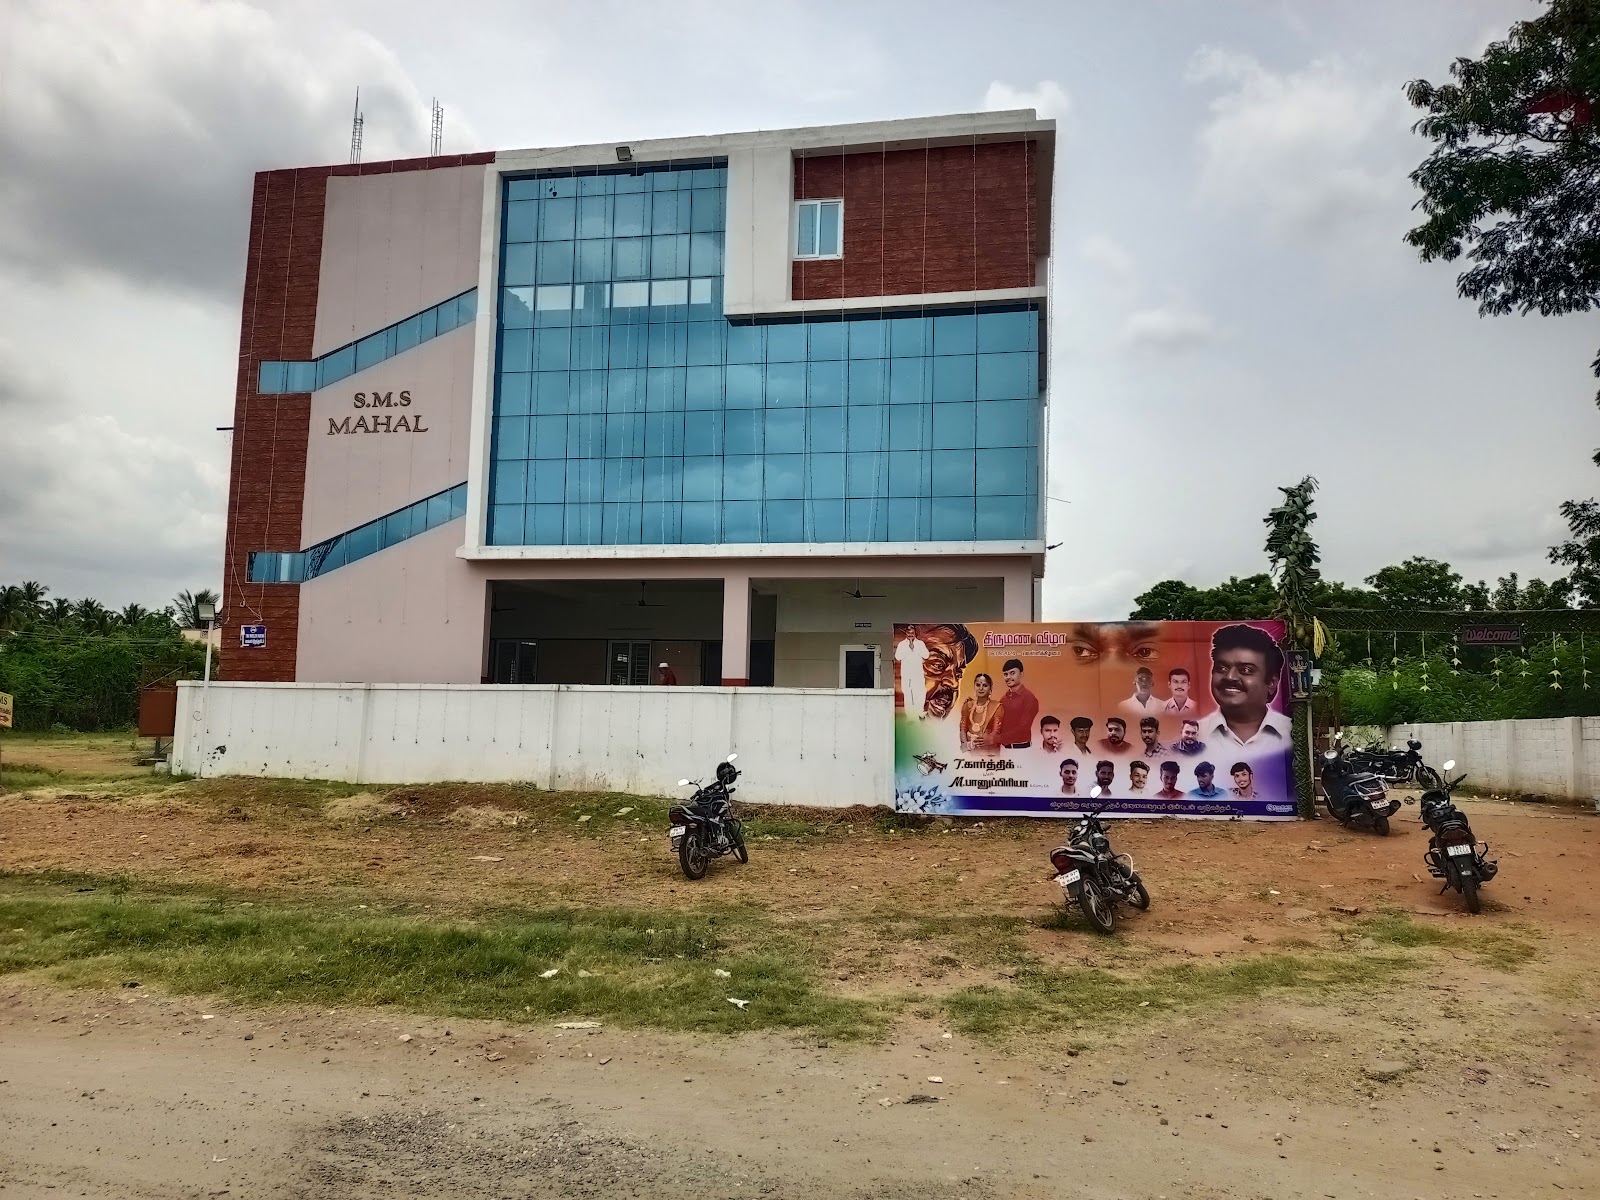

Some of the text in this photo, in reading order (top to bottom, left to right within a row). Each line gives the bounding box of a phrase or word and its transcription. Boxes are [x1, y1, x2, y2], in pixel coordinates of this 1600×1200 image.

[353, 391, 411, 408] S.M.S
[327, 415, 429, 435] MAHAL
[983, 631, 1067, 647] திருமண விழா
